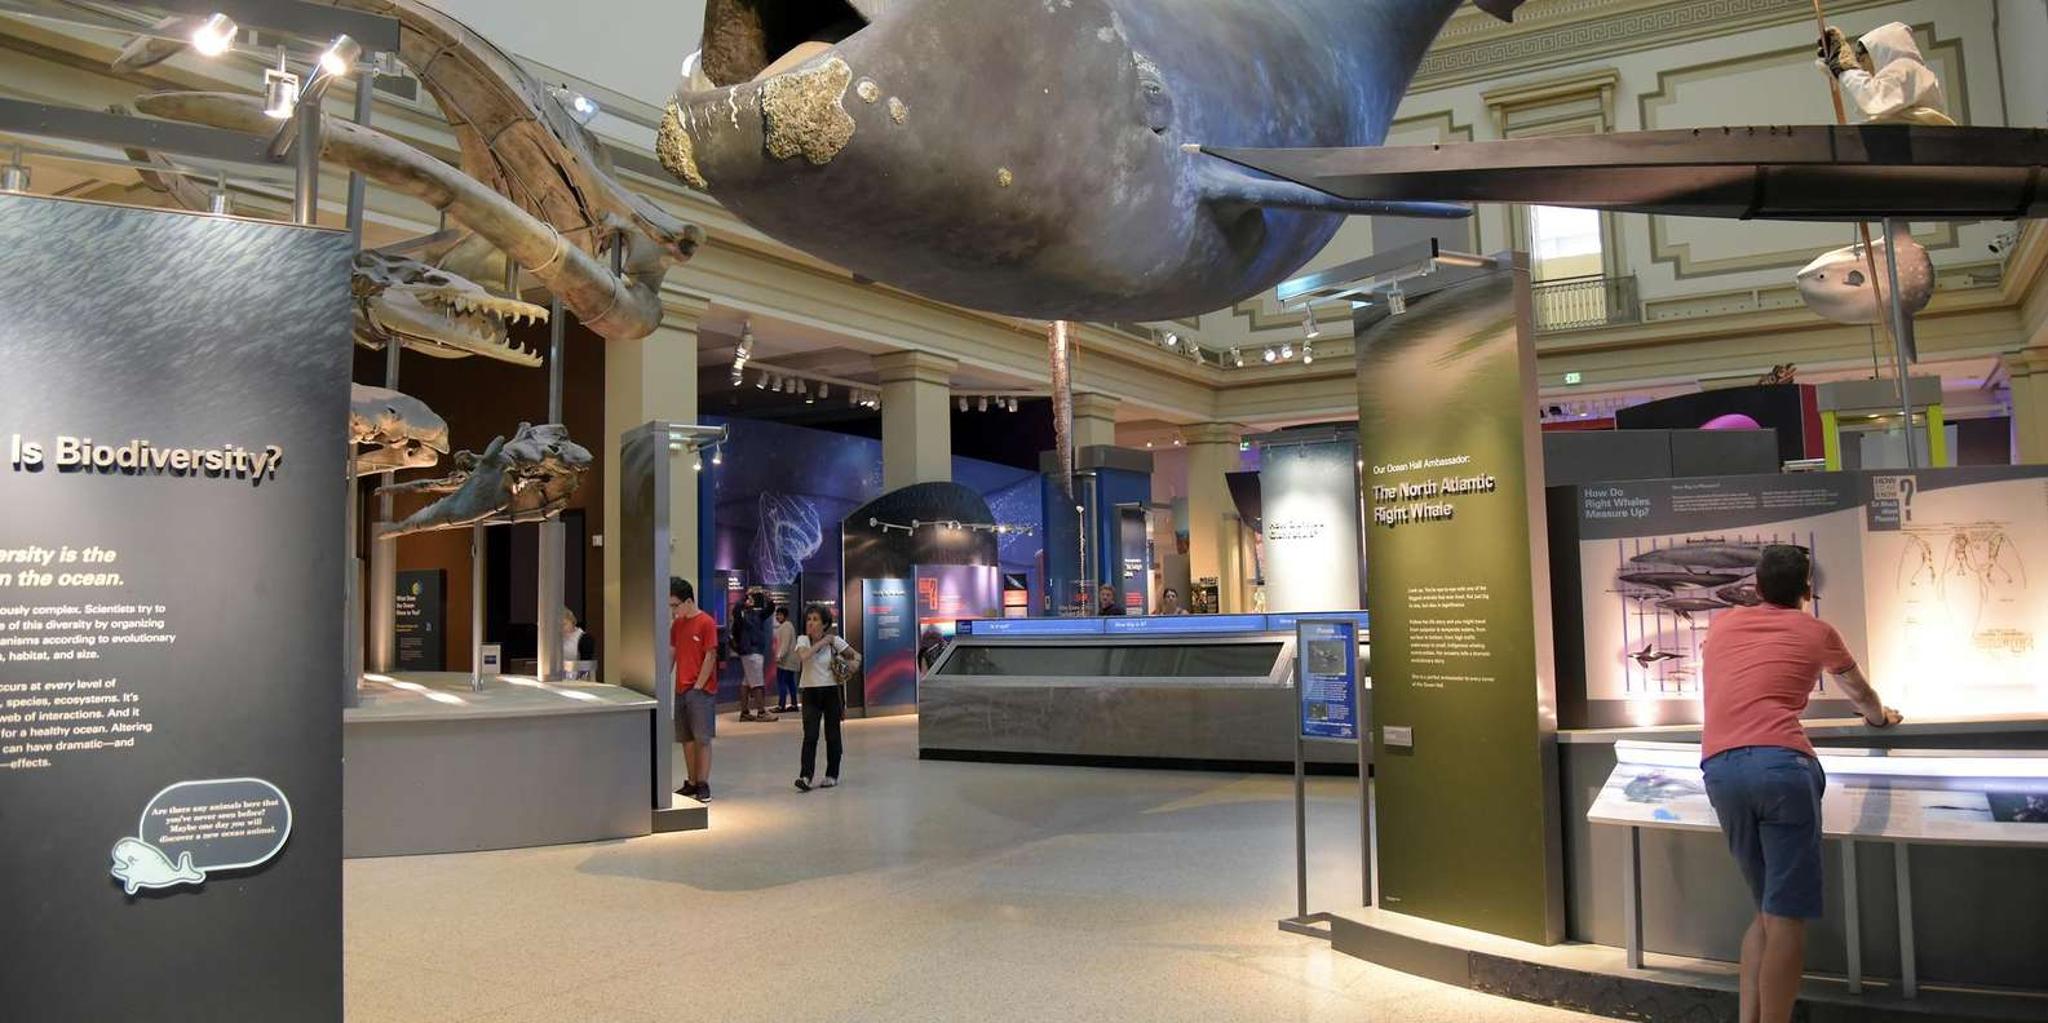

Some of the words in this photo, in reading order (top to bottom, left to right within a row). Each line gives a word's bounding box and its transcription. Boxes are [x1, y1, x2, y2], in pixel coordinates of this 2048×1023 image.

[11, 433, 42, 469] Is
[56, 435, 283, 482] Biodiversity?
[1372, 465, 1386, 474] Our
[1386, 463, 1409, 473] Ocean
[1409, 460, 1423, 470] Hall
[1423, 454, 1471, 468] Ambassador:
[1372, 484, 1397, 502] The
[1399, 477, 1438, 499] North
[1440, 473, 1497, 495] Atlantic
[1583, 488, 1608, 497] How
[1609, 487, 1624, 497] Do
[1585, 499, 1612, 510] Right
[1374, 505, 1409, 525] Right
[1410, 501, 1454, 520] Whale
[1585, 509, 1629, 518] Measure
[59, 545, 78, 563] is
[82, 546, 116, 563] the
[18, 569, 53, 587] the
[58, 571, 124, 587] ocean.
[0, 605, 30, 616] ously
[32, 604, 82, 616] complex.
[84, 604, 135, 614] Scientists
[137, 604, 153, 615] try
[154, 605, 166, 614] to
[8, 620, 21, 630] of
[23, 620, 43, 630] this
[45, 619, 93, 630] diversity
[94, 620, 108, 630] by
[110, 619, 165, 630] organizing
[0, 635, 40, 645] anisms
[42, 634, 96, 646] according
[98, 635, 110, 644] to
[111, 633, 176, 645] evolutionary
[9, 651, 50, 661] habitat,
[53, 650, 74, 660] and
[76, 650, 100, 659] size.
[30, 682, 42, 691] at
[44, 681, 75, 692] every
[77, 679, 103, 689] level
[104, 678, 116, 688] of
[6, 696, 51, 708] species,
[53, 695, 121, 706] ecosystems.
[123, 692, 140, 703] It's
[0, 713, 22, 723] web
[24, 712, 36, 722] of
[38, 710, 104, 721] interactions.
[107, 708, 130, 718] And
[132, 708, 141, 717] it
[1, 728, 16, 738] for
[30, 726, 71, 737] healthy
[73, 725, 108, 735] ocean.
[111, 722, 153, 733] Altering
[3, 744, 23, 754] can
[26, 743, 53, 752] have
[151, 807, 167, 817] Are
[168, 805, 191, 815] there
[192, 804, 208, 814] any
[209, 801, 242, 812] animals
[243, 800, 261, 809] here
[262, 799, 279, 807] that
[193, 813, 217, 821] never
[218, 812, 237, 820] seen
[169, 823, 197, 834] Maybe
[198, 823, 214, 831] one
[214, 821, 229, 831] day
[230, 821, 245, 831] you
[246, 818, 263, 827] will
[159, 832, 194, 844] discover
[202, 831, 219, 839] new
[220, 829, 246, 839] ocean
[246, 826, 277, 836] animal.
